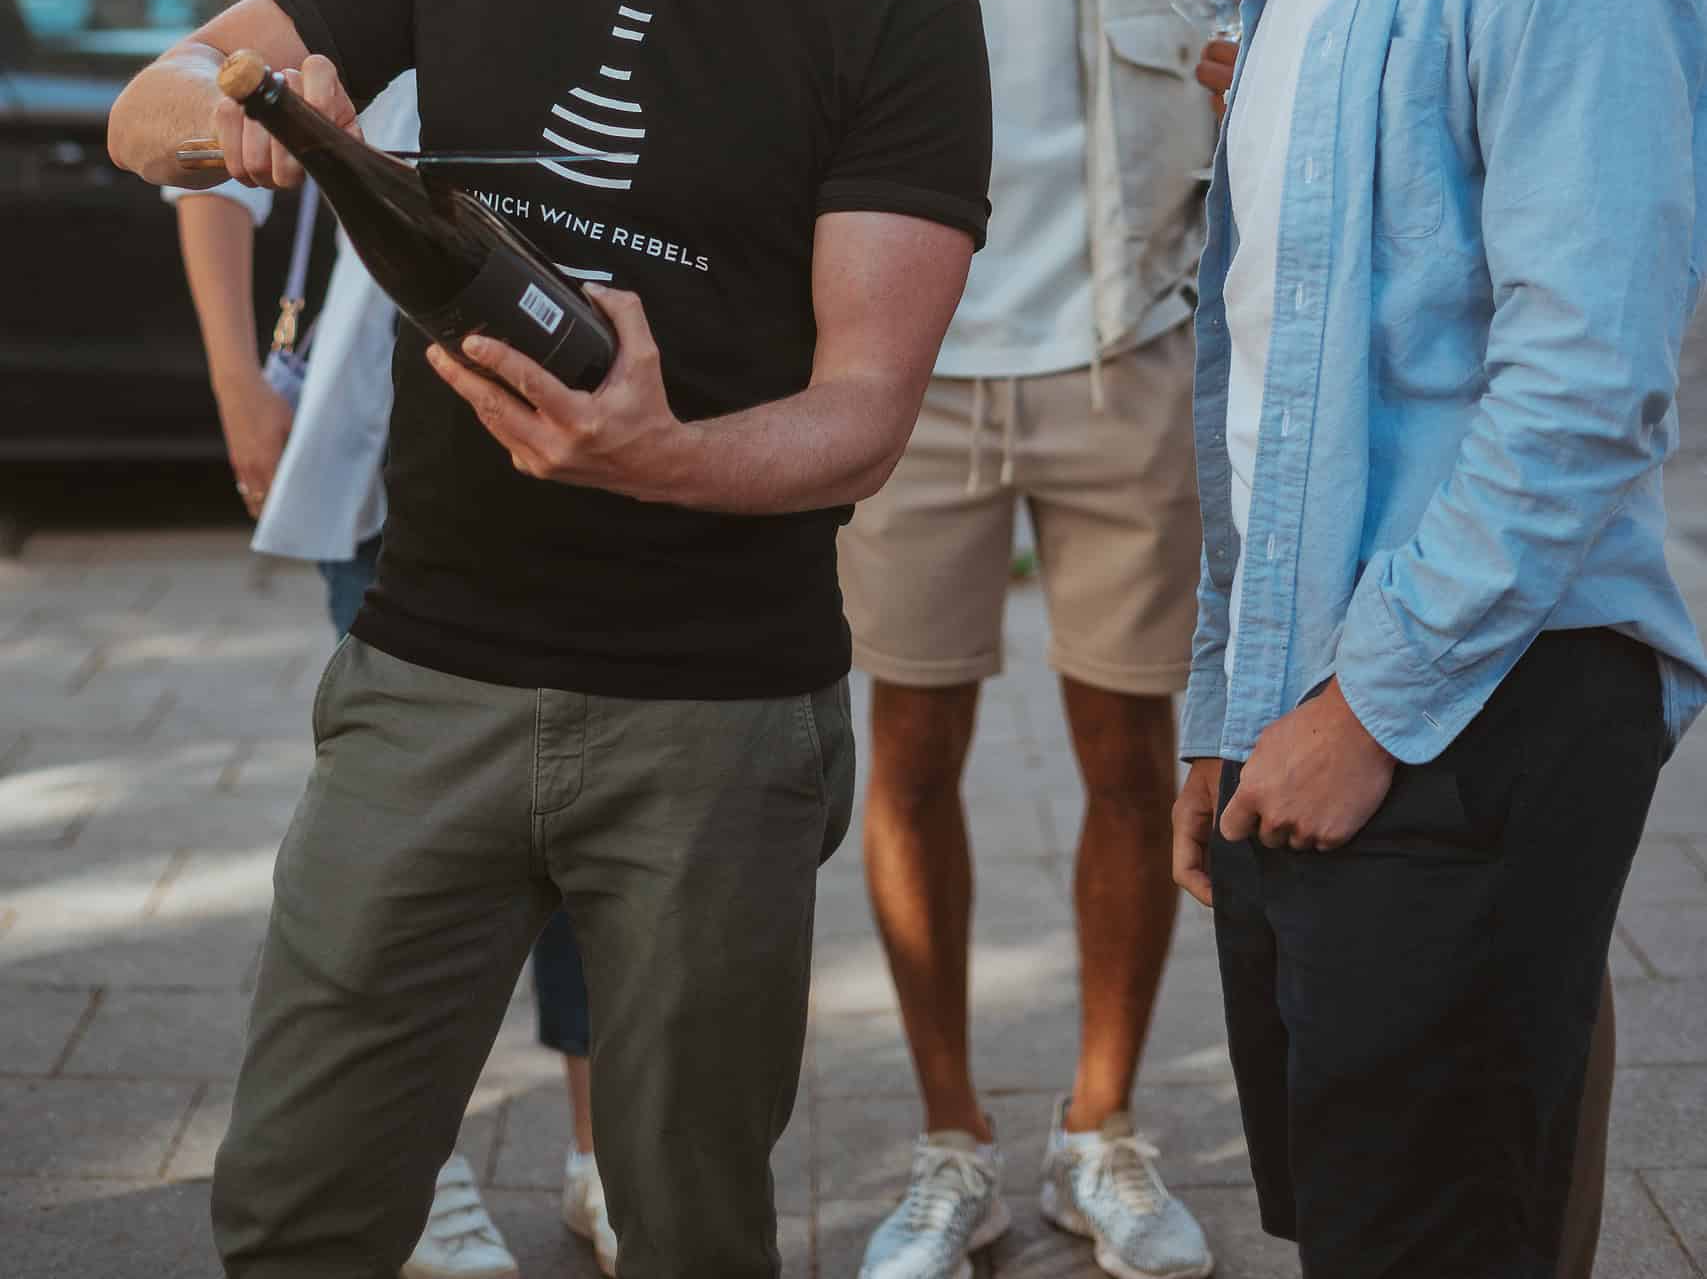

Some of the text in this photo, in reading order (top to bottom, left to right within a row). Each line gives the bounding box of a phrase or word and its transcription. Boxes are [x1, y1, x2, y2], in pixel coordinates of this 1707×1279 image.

[466, 189, 709, 271] NICH WINE REBELS
